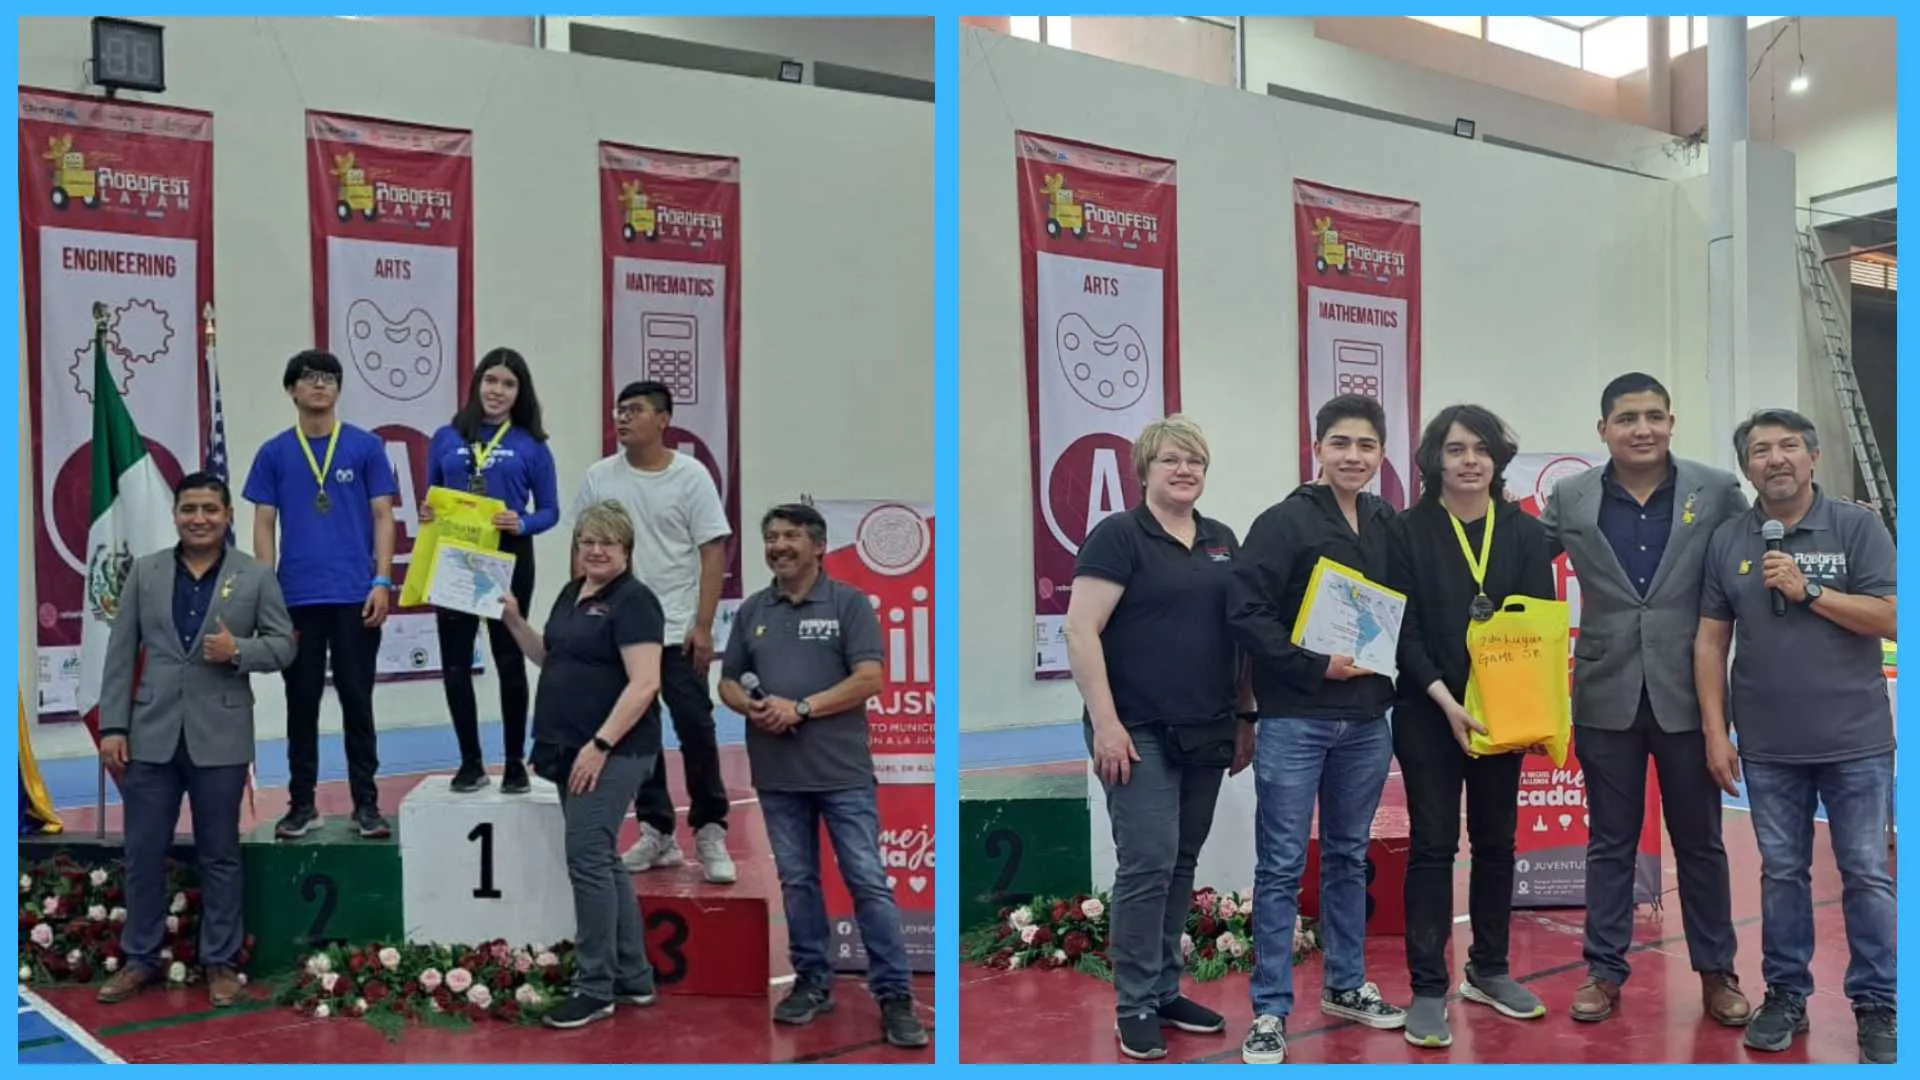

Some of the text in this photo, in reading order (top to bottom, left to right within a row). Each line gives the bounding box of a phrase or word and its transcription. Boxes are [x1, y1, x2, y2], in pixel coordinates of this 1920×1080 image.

[62, 246, 177, 278] ENGINEERING
[374, 257, 412, 281] ARTS
[625, 272, 715, 297] MATHEMATICS
[1083, 274, 1119, 297] ARTS
[1318, 301, 1398, 328] MATHEMATICS
[467, 822, 502, 898] 1
[985, 828, 1033, 901] 2
[1533, 860, 1586, 871] JUVENTU
[301, 874, 347, 947] 2
[648, 907, 689, 985] 3
